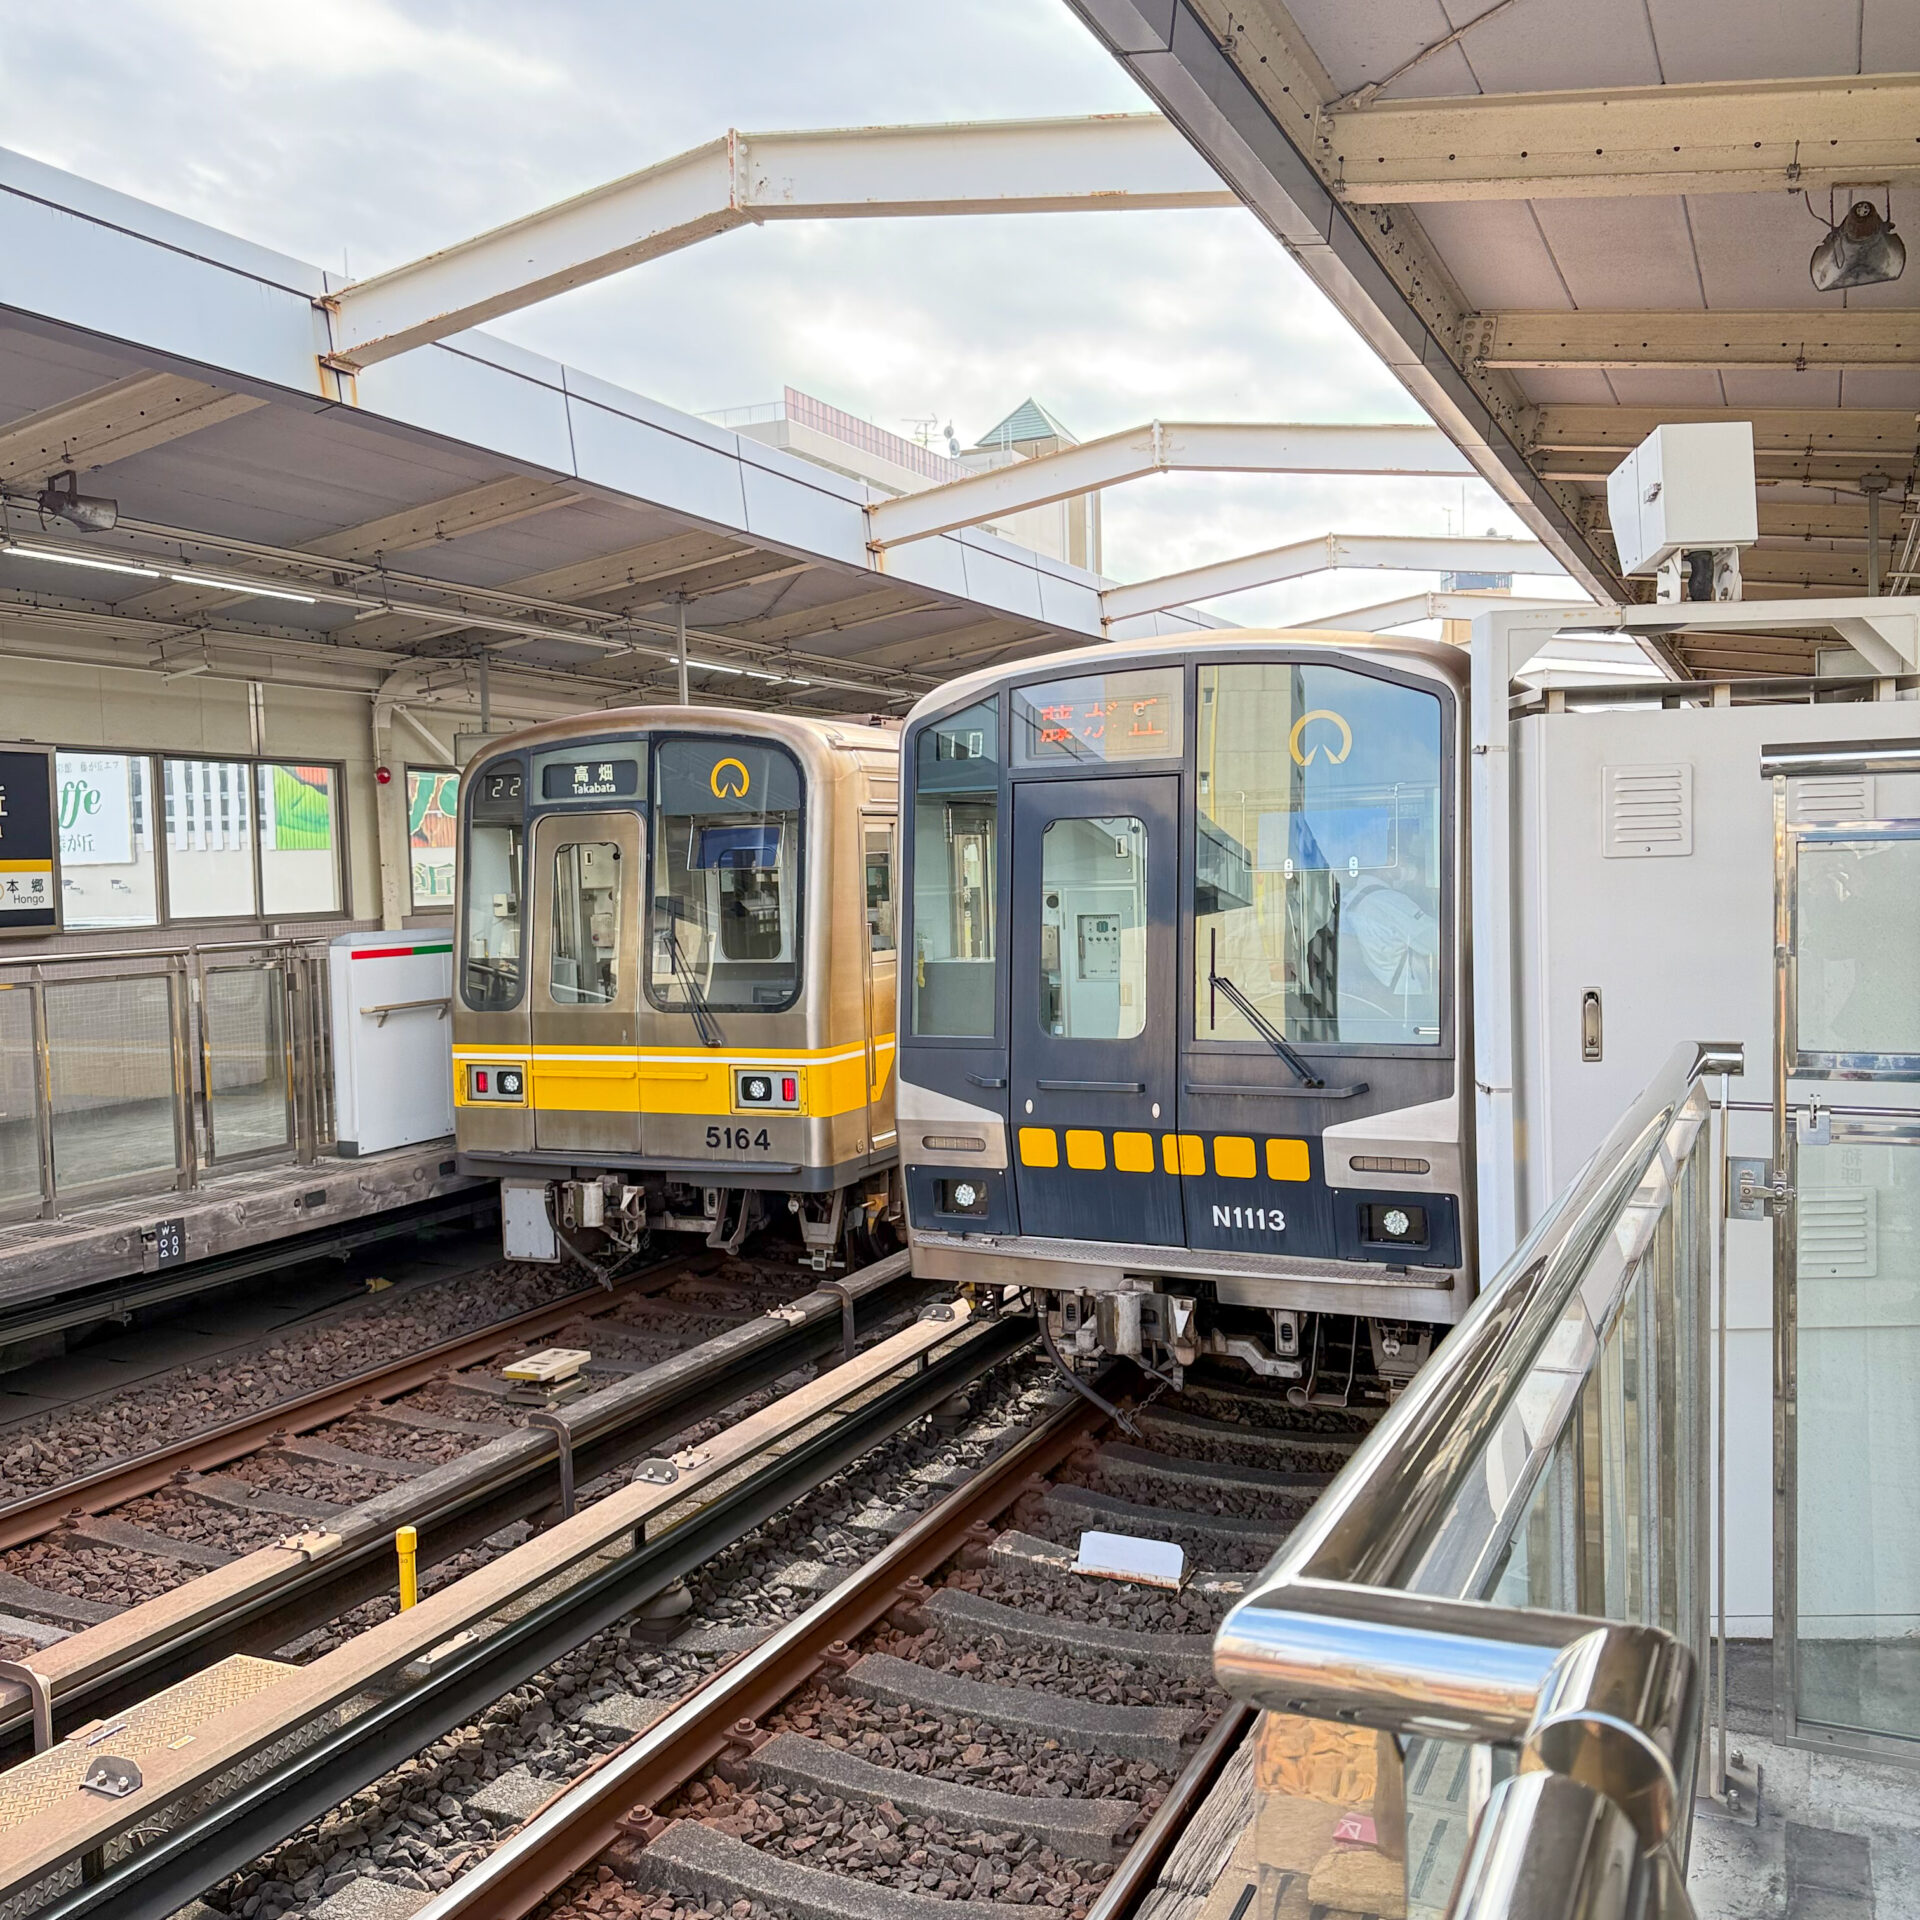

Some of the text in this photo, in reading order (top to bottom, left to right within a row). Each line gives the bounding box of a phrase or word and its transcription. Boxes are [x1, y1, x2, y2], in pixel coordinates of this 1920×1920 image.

[951, 732, 983, 758] 10
[574, 763, 614, 783] 高畑
[492, 777, 521, 797] 22
[572, 783, 616, 795] Takabata
[6, 879, 44, 894] 本郷
[13, 894, 45, 906] Hongo
[706, 1126, 771, 1150] 5164
[1212, 1205, 1286, 1231] N1113
